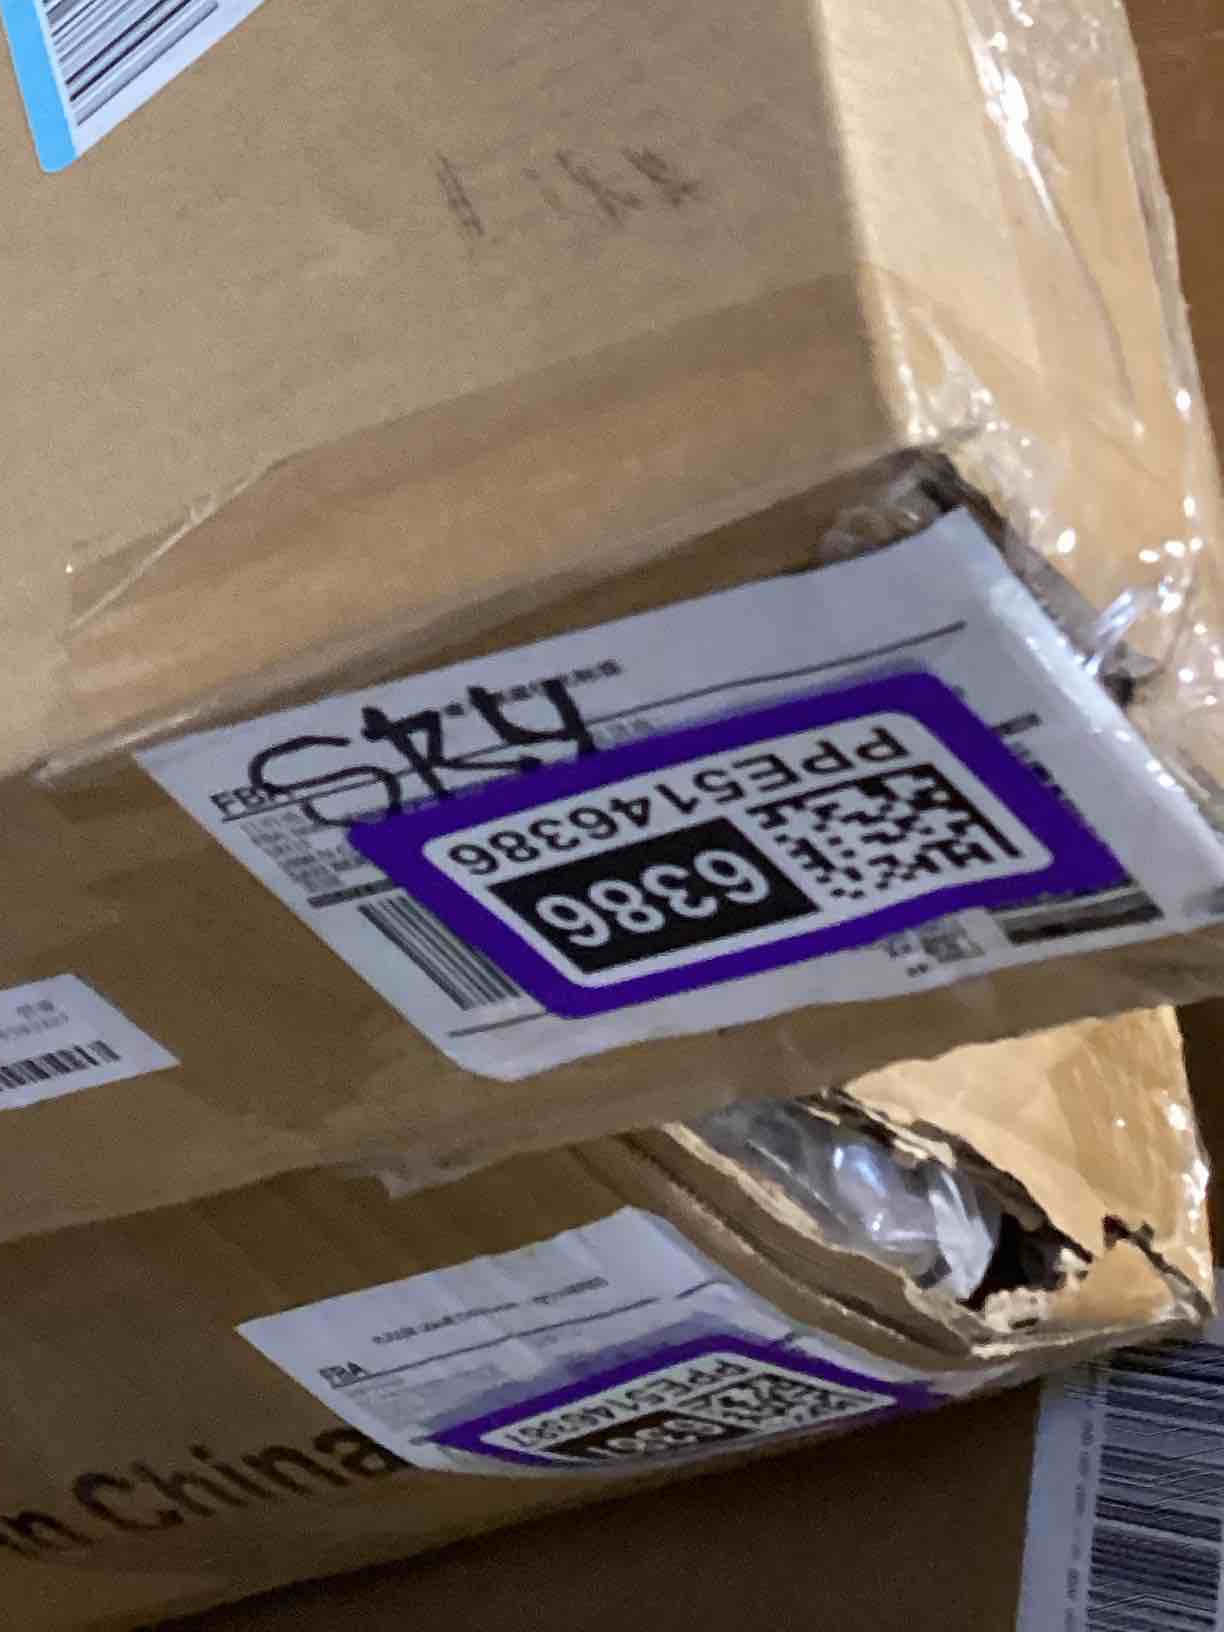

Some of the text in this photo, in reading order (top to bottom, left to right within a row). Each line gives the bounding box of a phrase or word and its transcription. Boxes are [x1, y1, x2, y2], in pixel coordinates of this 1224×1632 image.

[448, 727, 909, 876] PPE5146386
[534, 848, 771, 947] 6386
[73, 1426, 414, 1534] China
